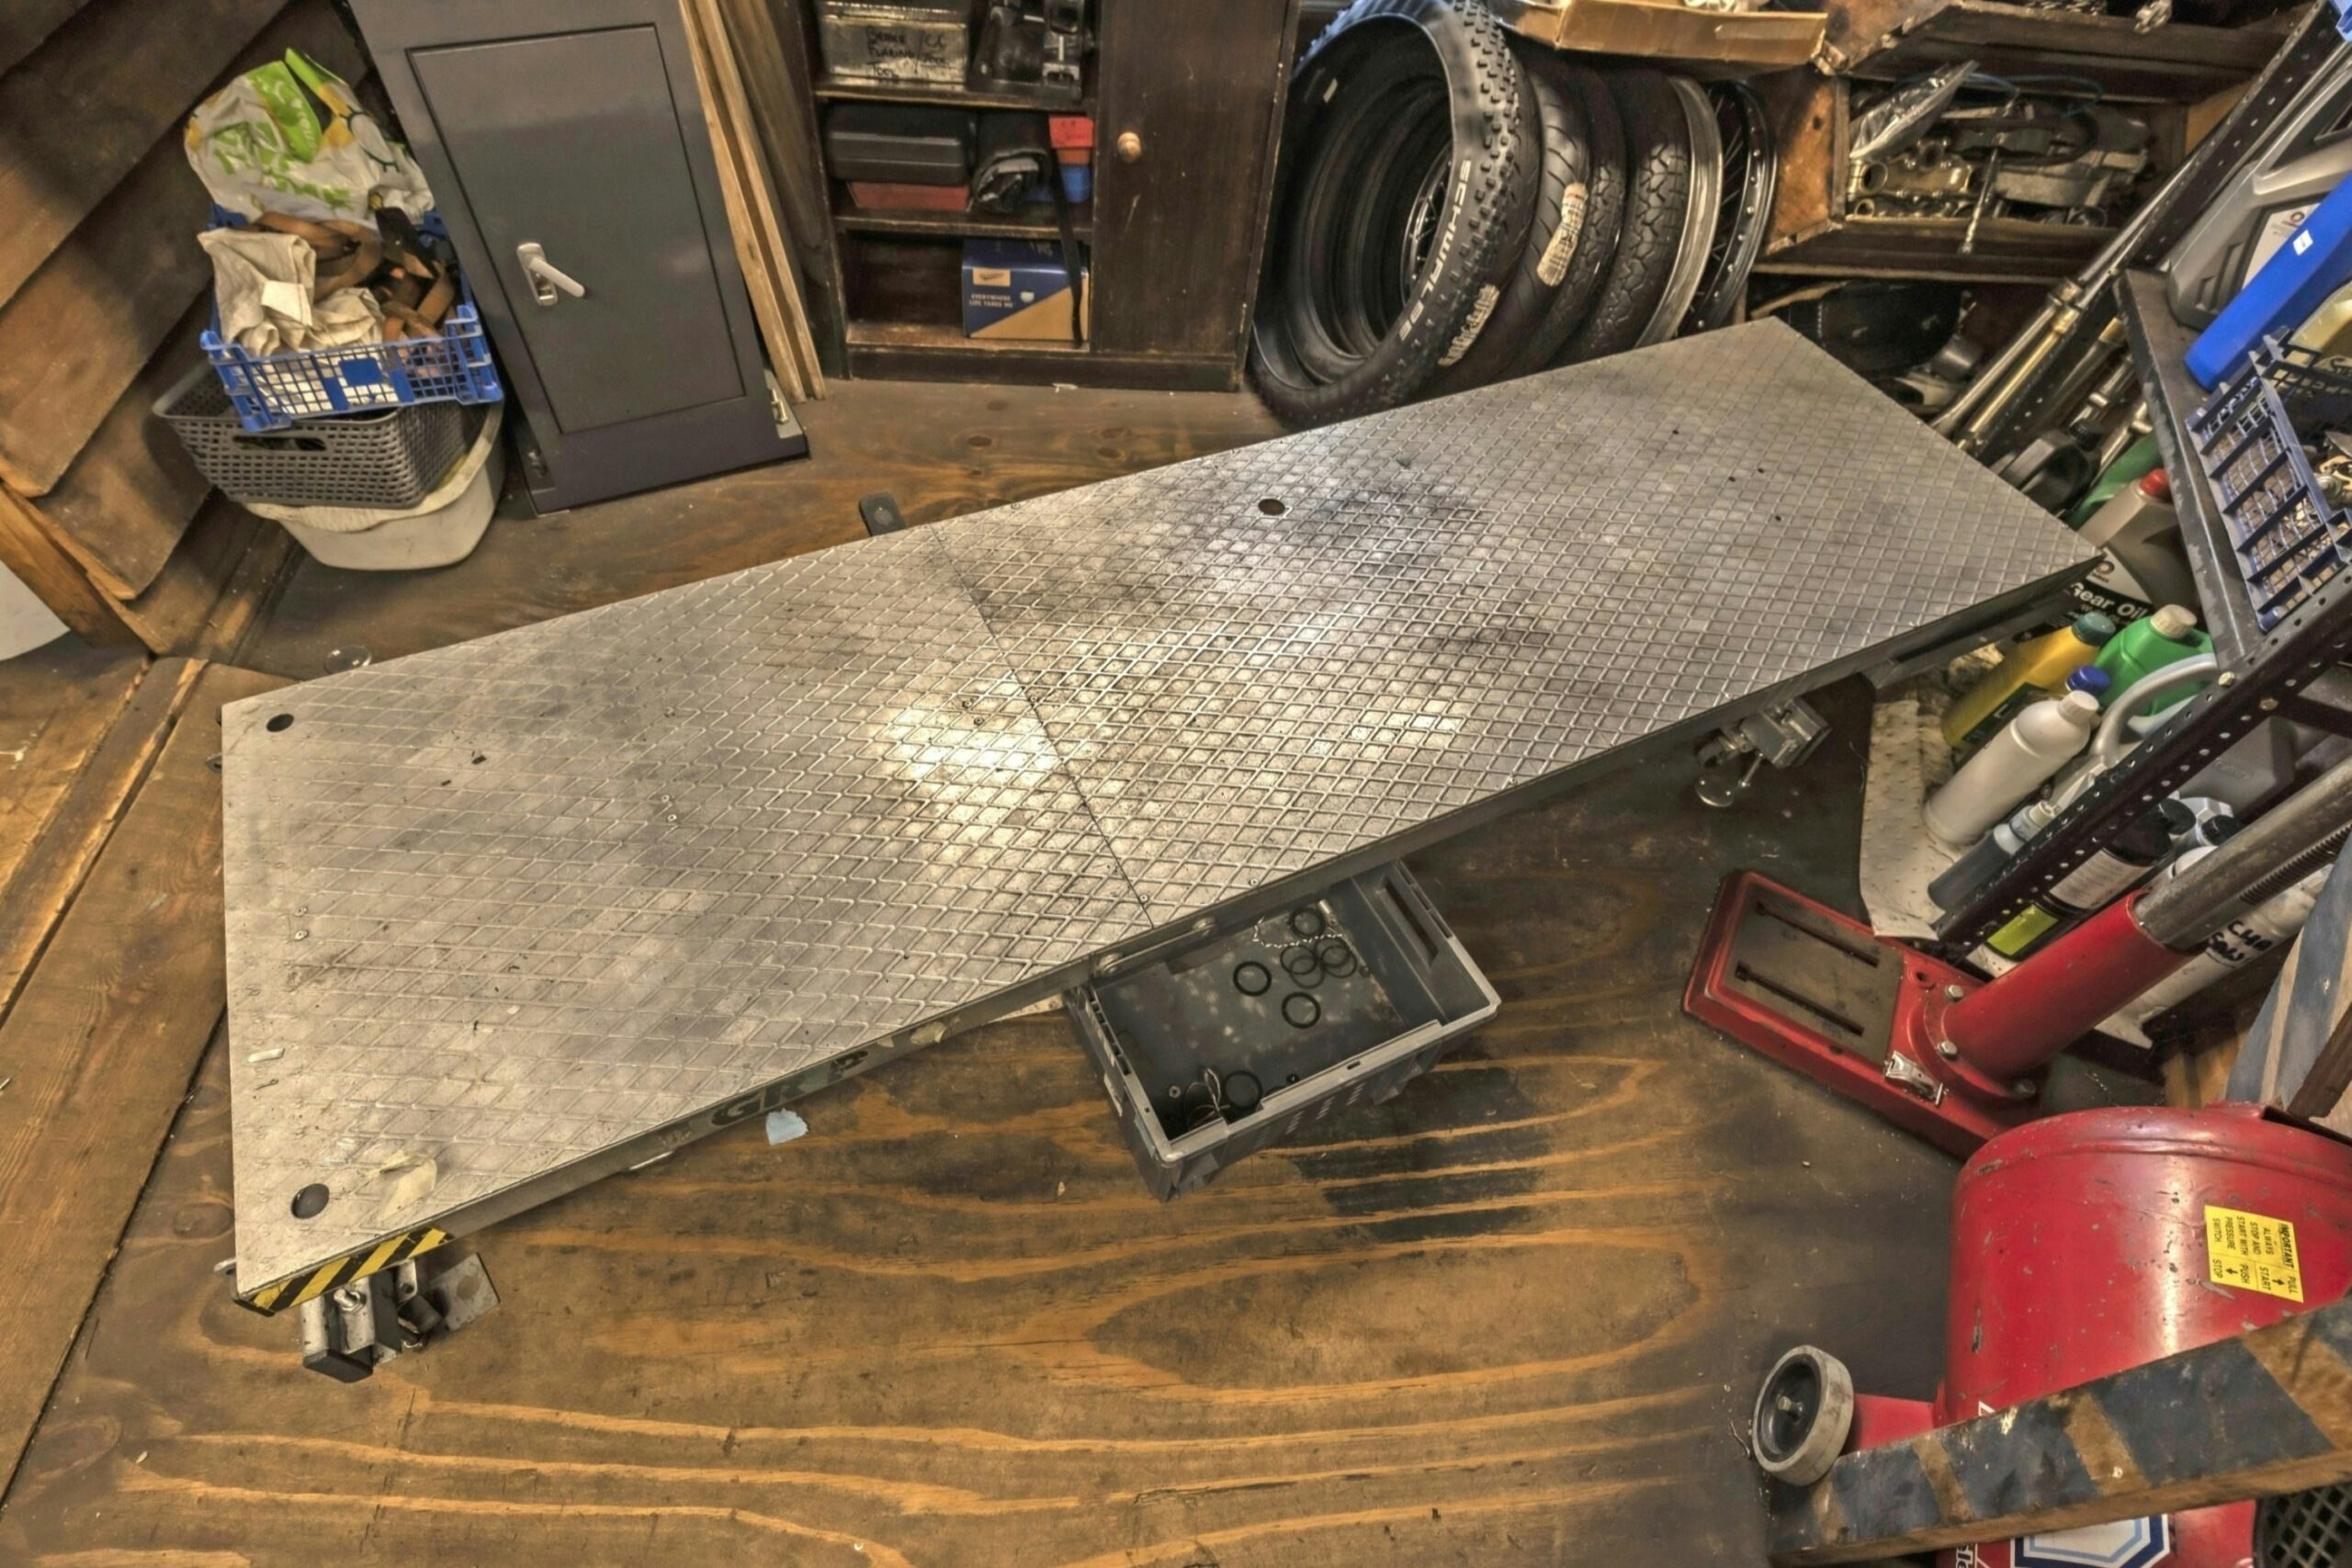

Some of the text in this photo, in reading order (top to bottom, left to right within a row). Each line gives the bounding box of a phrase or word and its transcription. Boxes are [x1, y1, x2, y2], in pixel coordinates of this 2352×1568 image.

[1399, 160, 1471, 341] SCHWALBE
[2117, 603, 2149, 619] Oil
[2225, 1216, 2236, 1250] PRESSURE
[2236, 1215, 2249, 1257] START WITH
[2250, 1222, 2262, 1256] STOP AND
[2264, 1227, 2275, 1256] ALWAYS
[2279, 1223, 2295, 1269] IMPORTANT
[2213, 1258, 2223, 1279] STOP
[2240, 1264, 2250, 1284] PUSH
[2259, 1266, 2272, 1291] START
[2288, 1276, 2298, 1293] PULL
